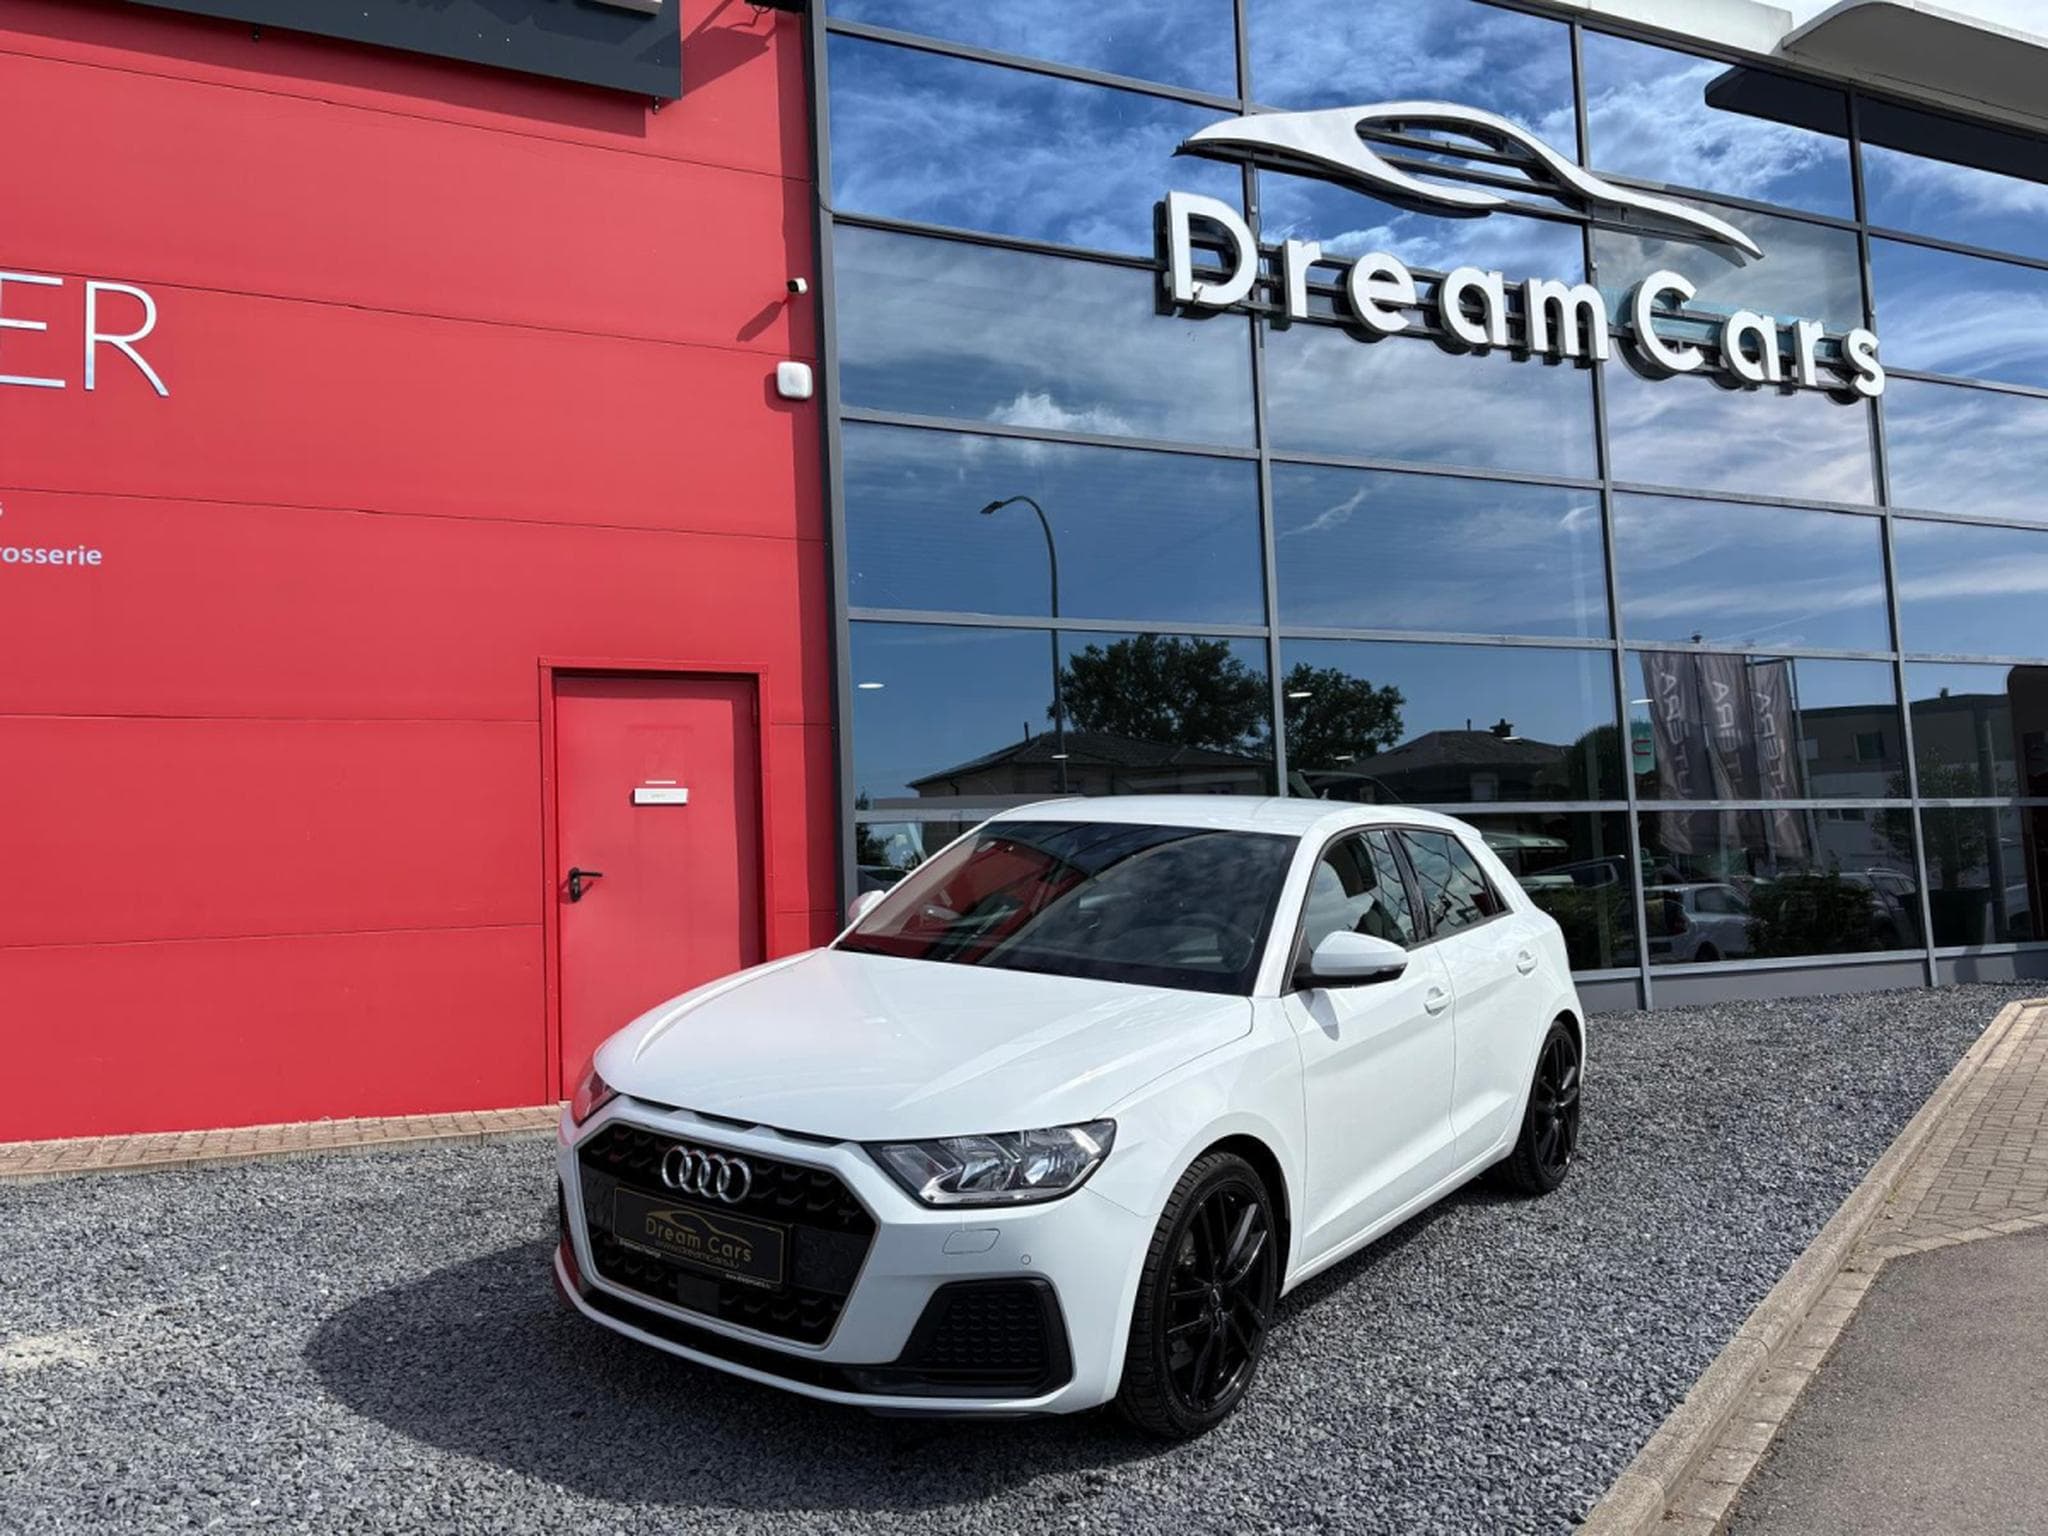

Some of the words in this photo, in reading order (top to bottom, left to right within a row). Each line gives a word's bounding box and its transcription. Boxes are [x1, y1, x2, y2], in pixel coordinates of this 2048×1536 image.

[1160, 190, 1608, 362] Dream
[1631, 269, 1886, 398] Cars
[0, 545, 103, 566] osserie
[645, 1217, 700, 1247] Dream
[707, 1236, 752, 1263] Cars
